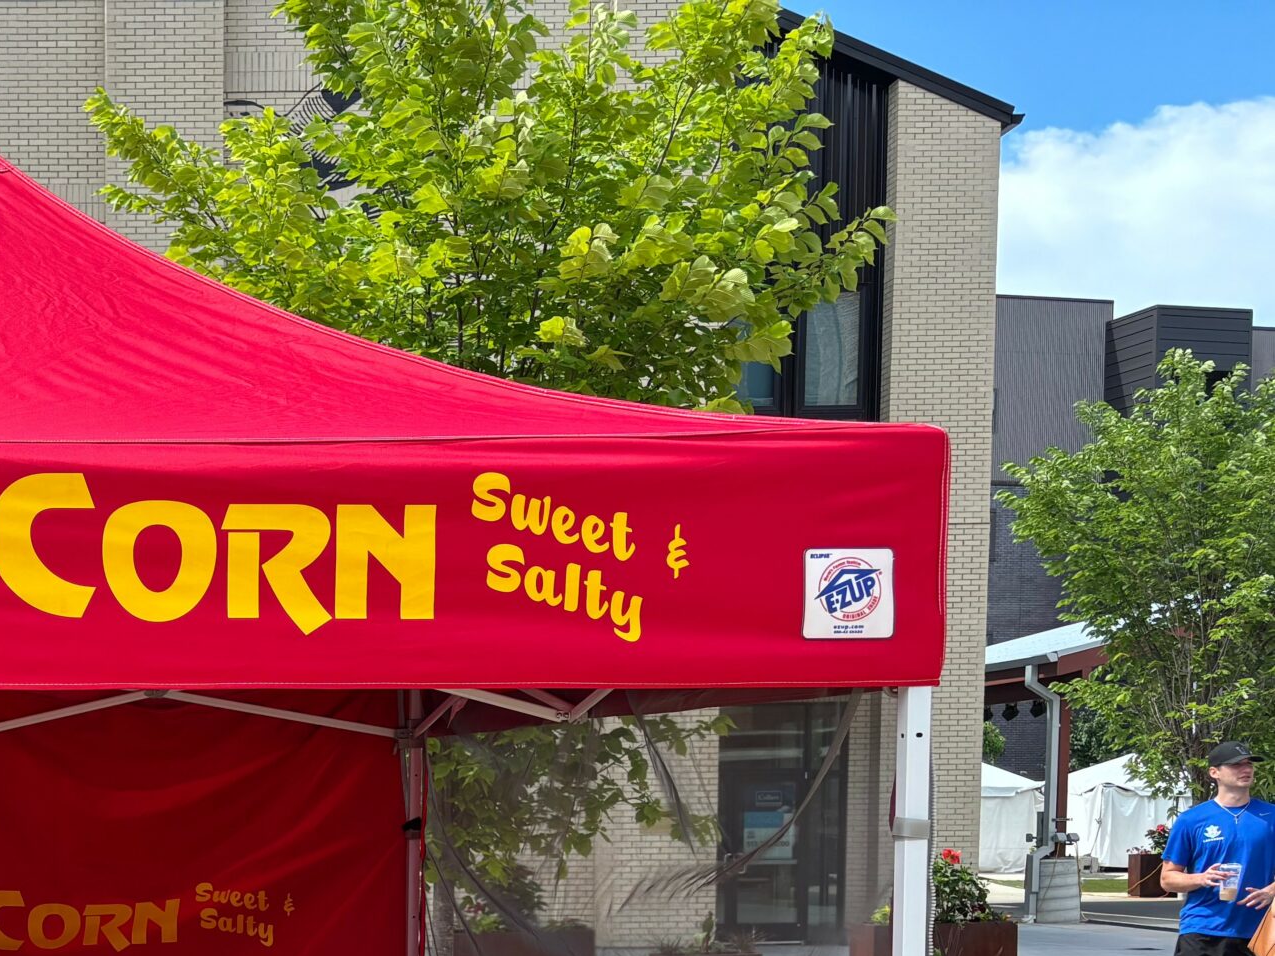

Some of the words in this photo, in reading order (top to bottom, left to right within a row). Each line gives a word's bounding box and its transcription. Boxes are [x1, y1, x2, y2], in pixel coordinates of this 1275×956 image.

[472, 472, 635, 561] Sweet
[666, 524, 689, 579] &
[486, 543, 644, 644] Salty
[195, 882, 269, 911] Sweet
[199, 907, 274, 947] Salty
